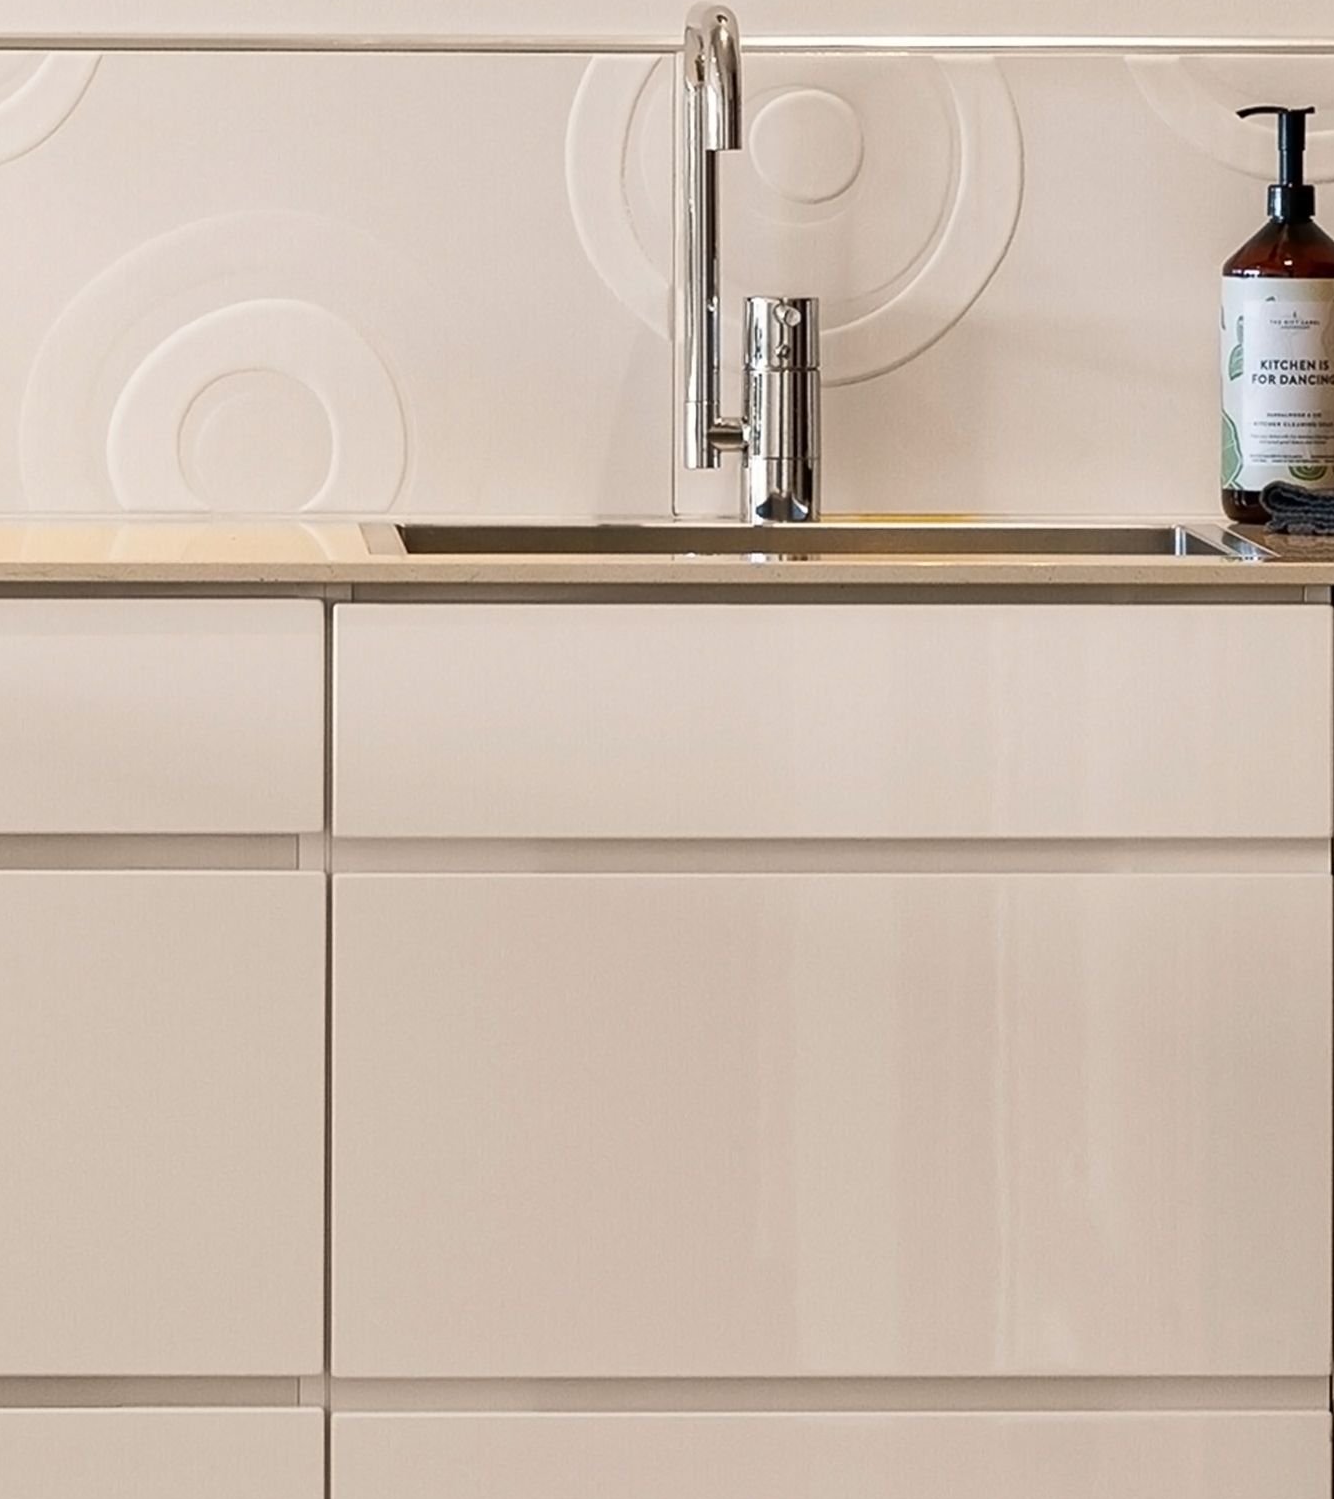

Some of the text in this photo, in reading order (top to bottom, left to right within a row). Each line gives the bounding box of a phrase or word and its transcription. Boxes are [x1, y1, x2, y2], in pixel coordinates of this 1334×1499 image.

[1260, 359, 1330, 371] KITCHEN IS
[1252, 374, 1277, 385] FOR
